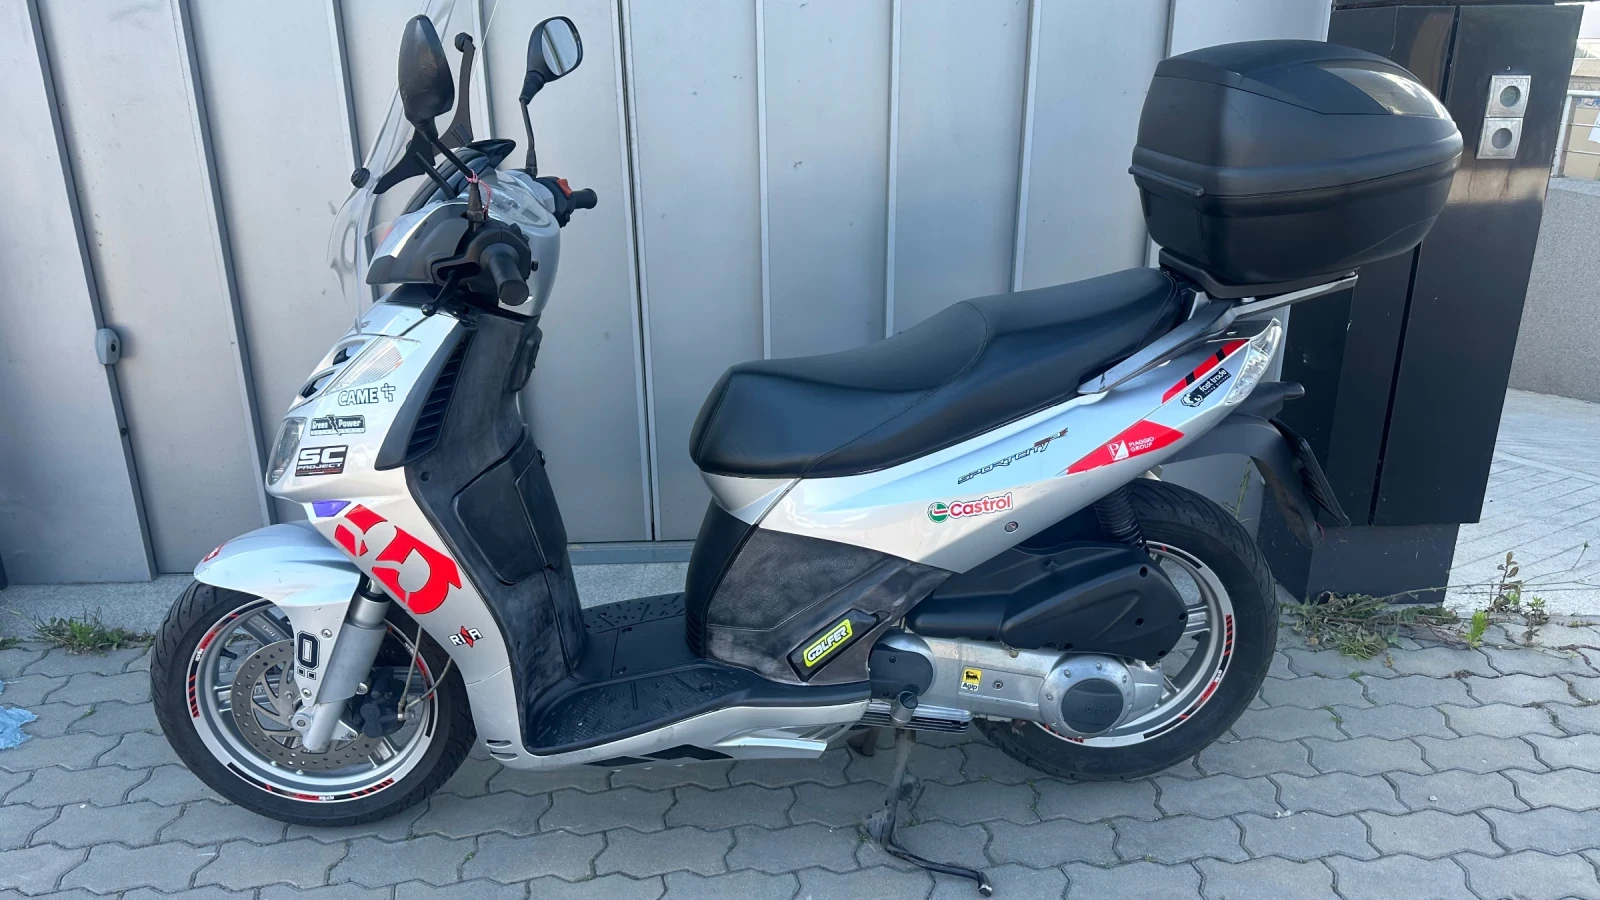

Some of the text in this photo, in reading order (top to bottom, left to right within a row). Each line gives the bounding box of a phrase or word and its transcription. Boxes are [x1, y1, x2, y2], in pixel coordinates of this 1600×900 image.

[338, 387, 379, 406] CAME
[338, 419, 361, 428] Power
[1128, 436, 1155, 448] PIAGGIO
[1130, 442, 1153, 453] GROUP
[300, 445, 348, 465] SC
[297, 462, 343, 471] PROJECT
[950, 495, 1011, 517] Castrol
[962, 682, 978, 691] Agip
